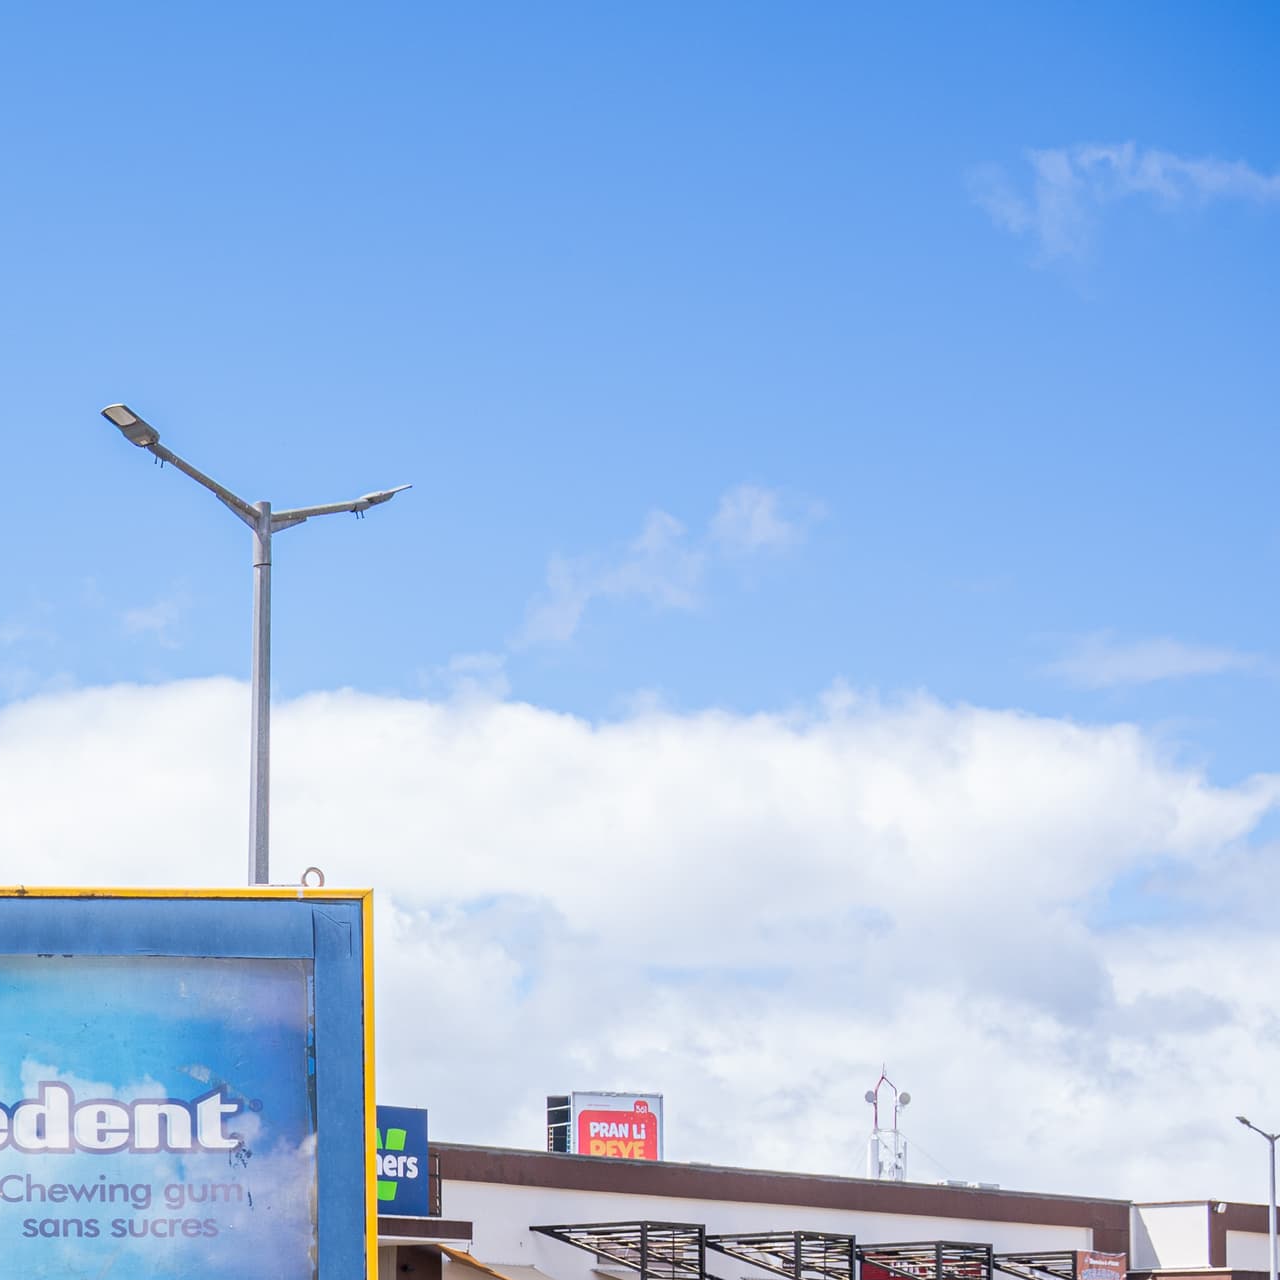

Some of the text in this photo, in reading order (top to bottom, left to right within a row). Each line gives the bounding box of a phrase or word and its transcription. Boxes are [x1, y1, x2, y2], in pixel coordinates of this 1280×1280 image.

[589, 1121, 629, 1138] PRAN
[164, 1182, 243, 1210] gum
[21, 1217, 220, 1239] sans sucres
